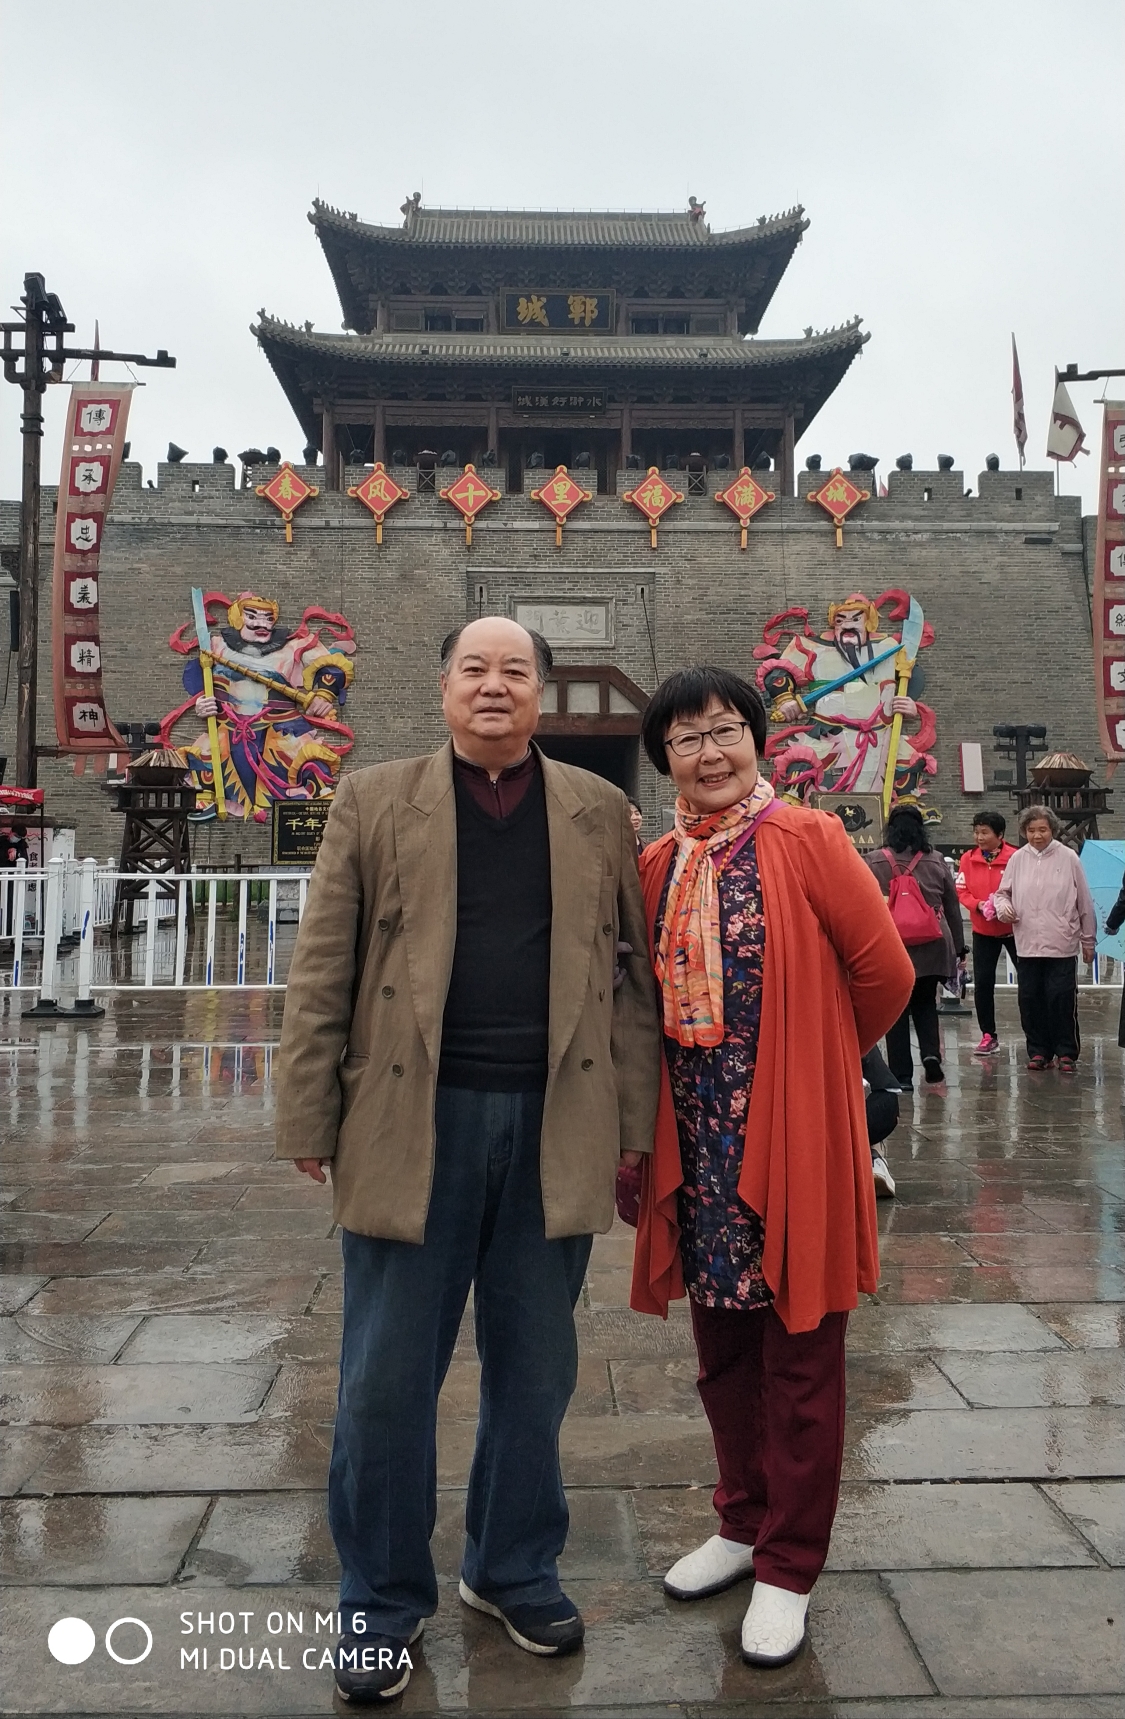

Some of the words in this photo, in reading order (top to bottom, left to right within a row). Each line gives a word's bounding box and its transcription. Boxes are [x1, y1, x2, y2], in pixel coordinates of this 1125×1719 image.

[275, 473, 301, 501] 春
[367, 479, 391, 502] 风
[455, 483, 486, 508] 十
[551, 481, 572, 505] 里
[640, 484, 665, 508] 福
[734, 484, 756, 510] 满
[825, 482, 851, 506] 城
[285, 818, 328, 831] 千年
